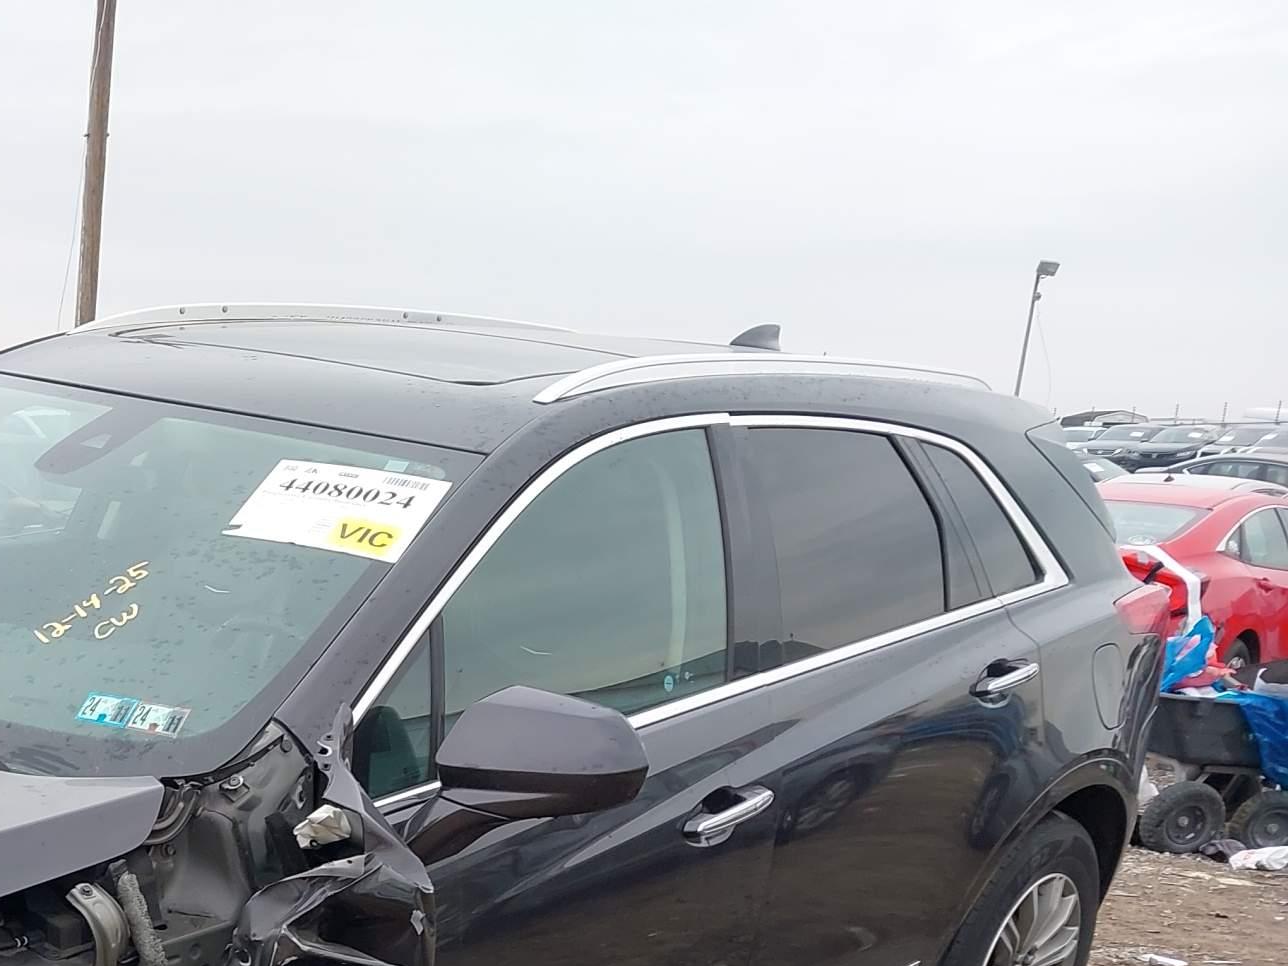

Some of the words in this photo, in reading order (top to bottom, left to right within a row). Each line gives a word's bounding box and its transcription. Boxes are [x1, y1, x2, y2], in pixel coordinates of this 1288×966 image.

[279, 477, 416, 510] 44080024
[339, 522, 394, 549] VIC
[82, 697, 102, 716] 24
[112, 706, 130, 723] 11
[132, 705, 152, 726] 24
[166, 715, 184, 734] 11
